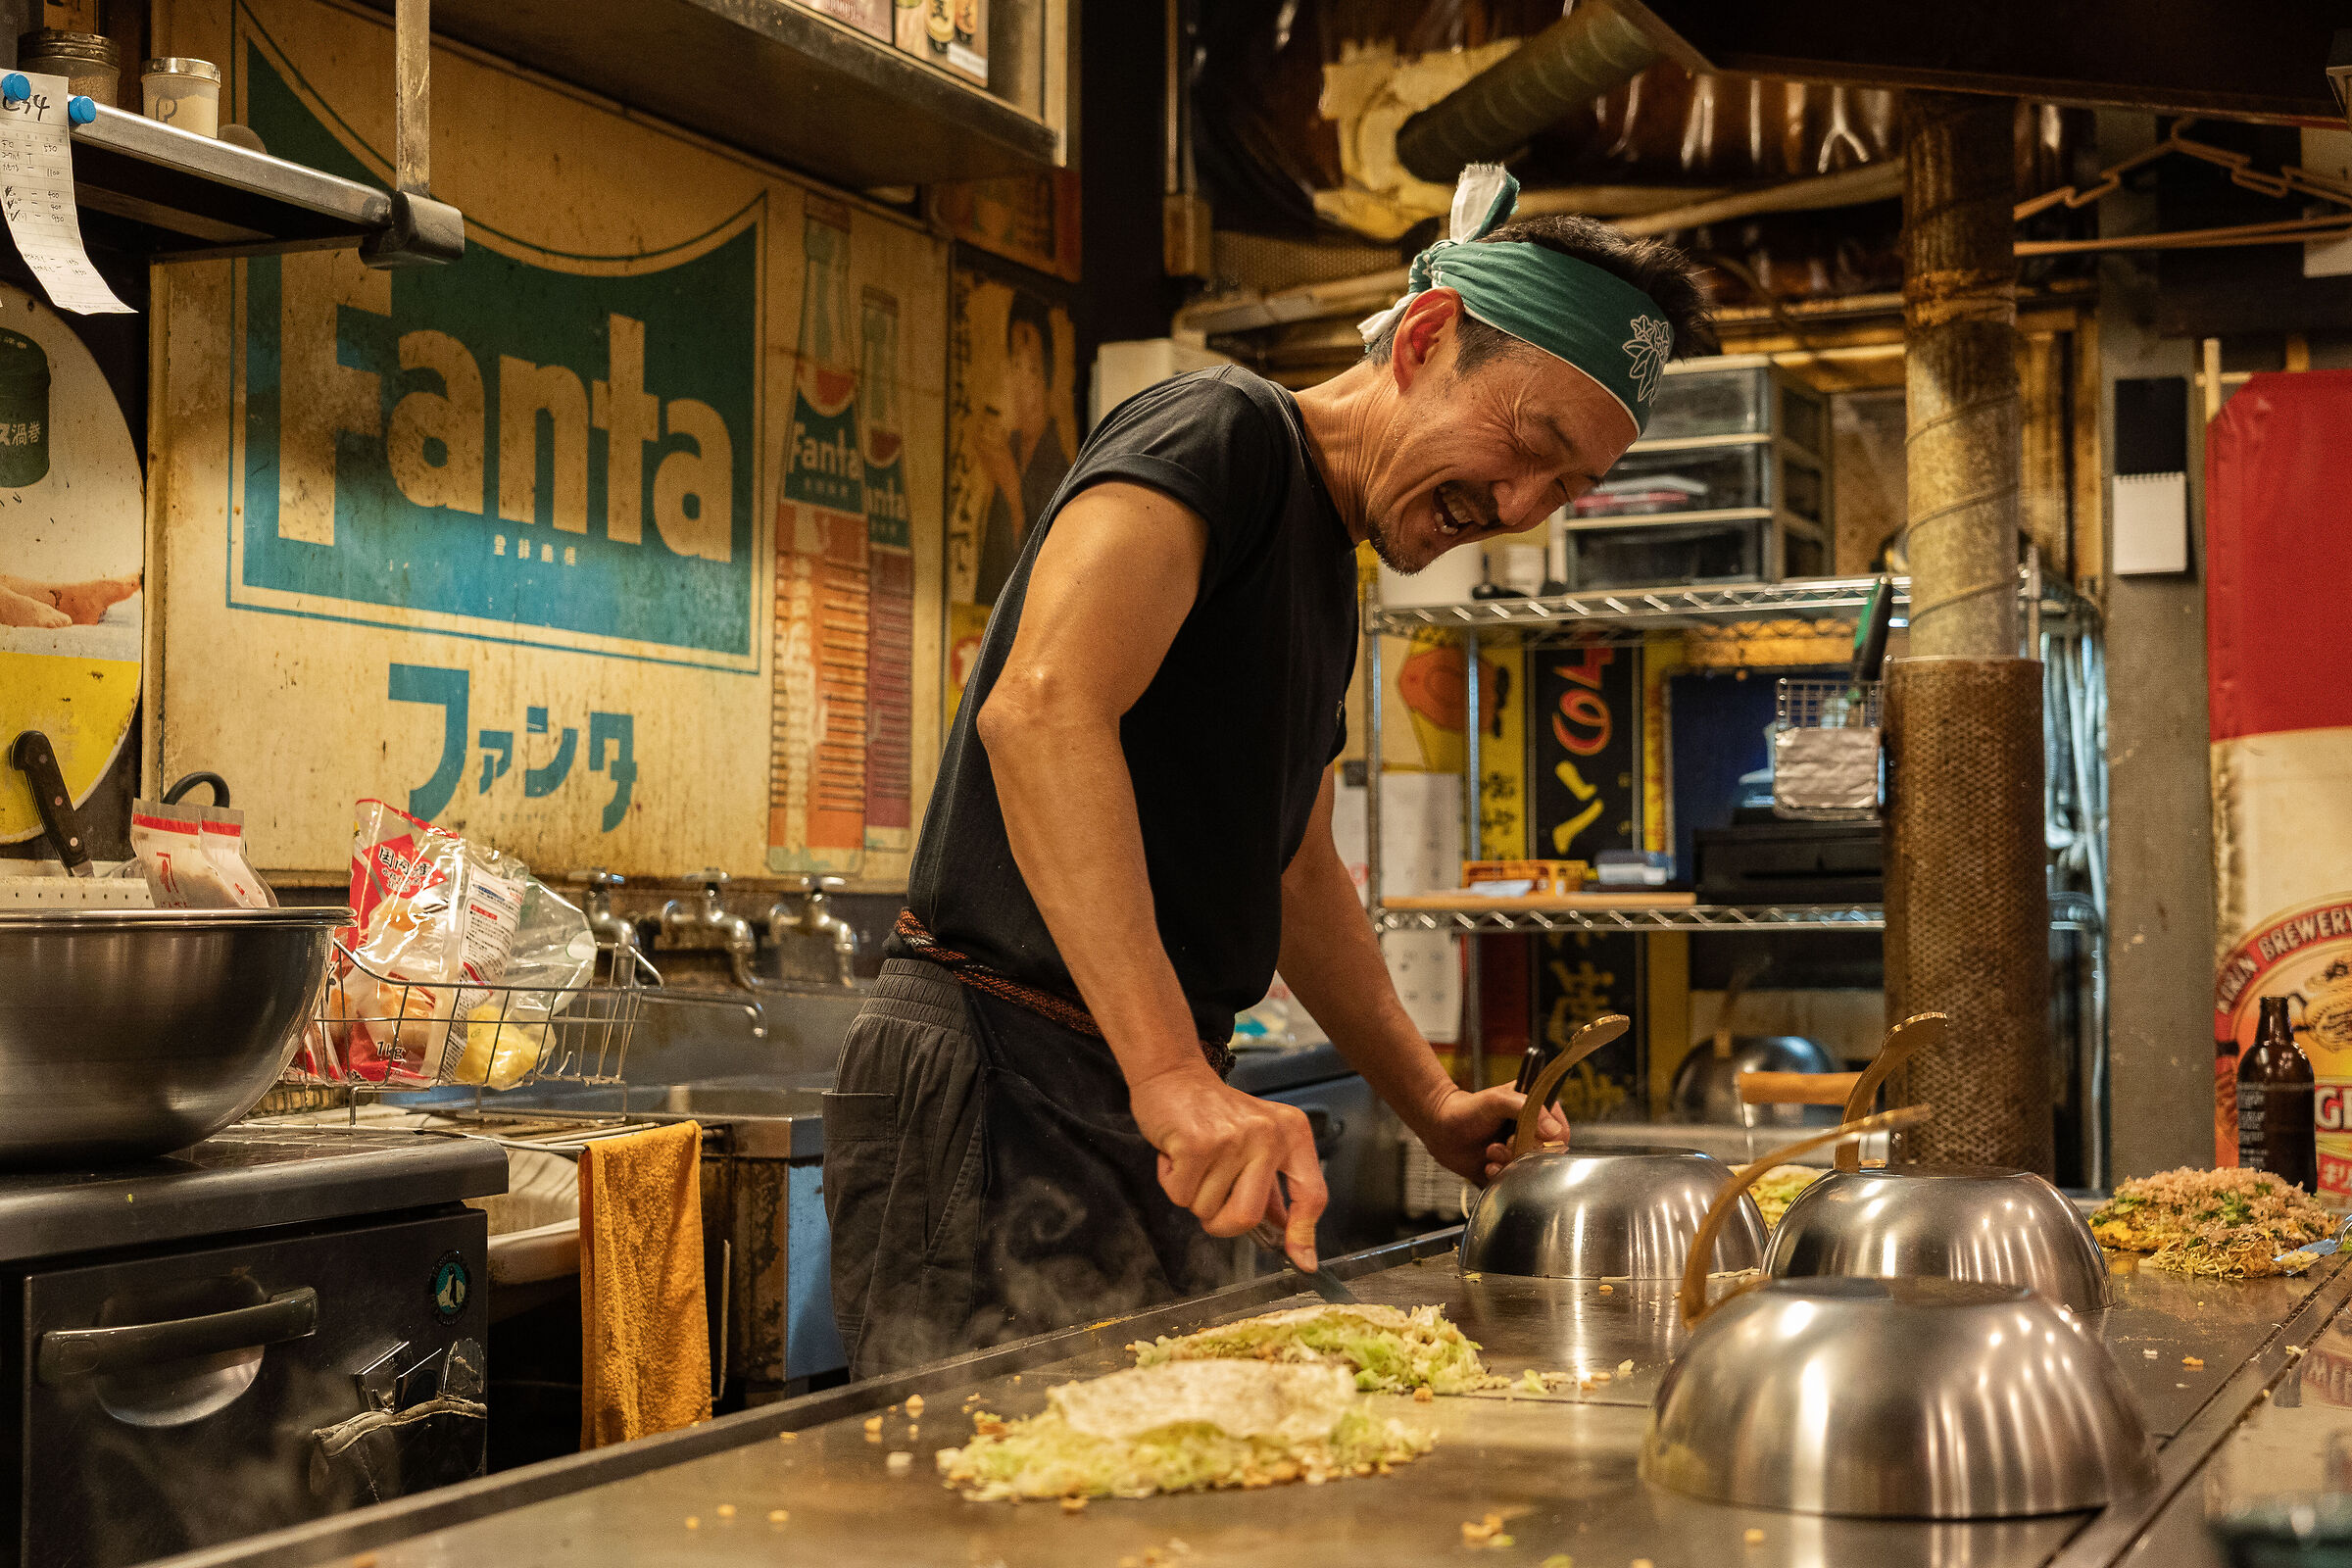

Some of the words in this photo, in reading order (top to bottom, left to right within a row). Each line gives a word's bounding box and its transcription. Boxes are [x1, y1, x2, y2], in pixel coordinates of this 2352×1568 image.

[278, 247, 732, 564] Fanta
[787, 421, 864, 480] Fanta
[388, 662, 638, 833] ファンタ
